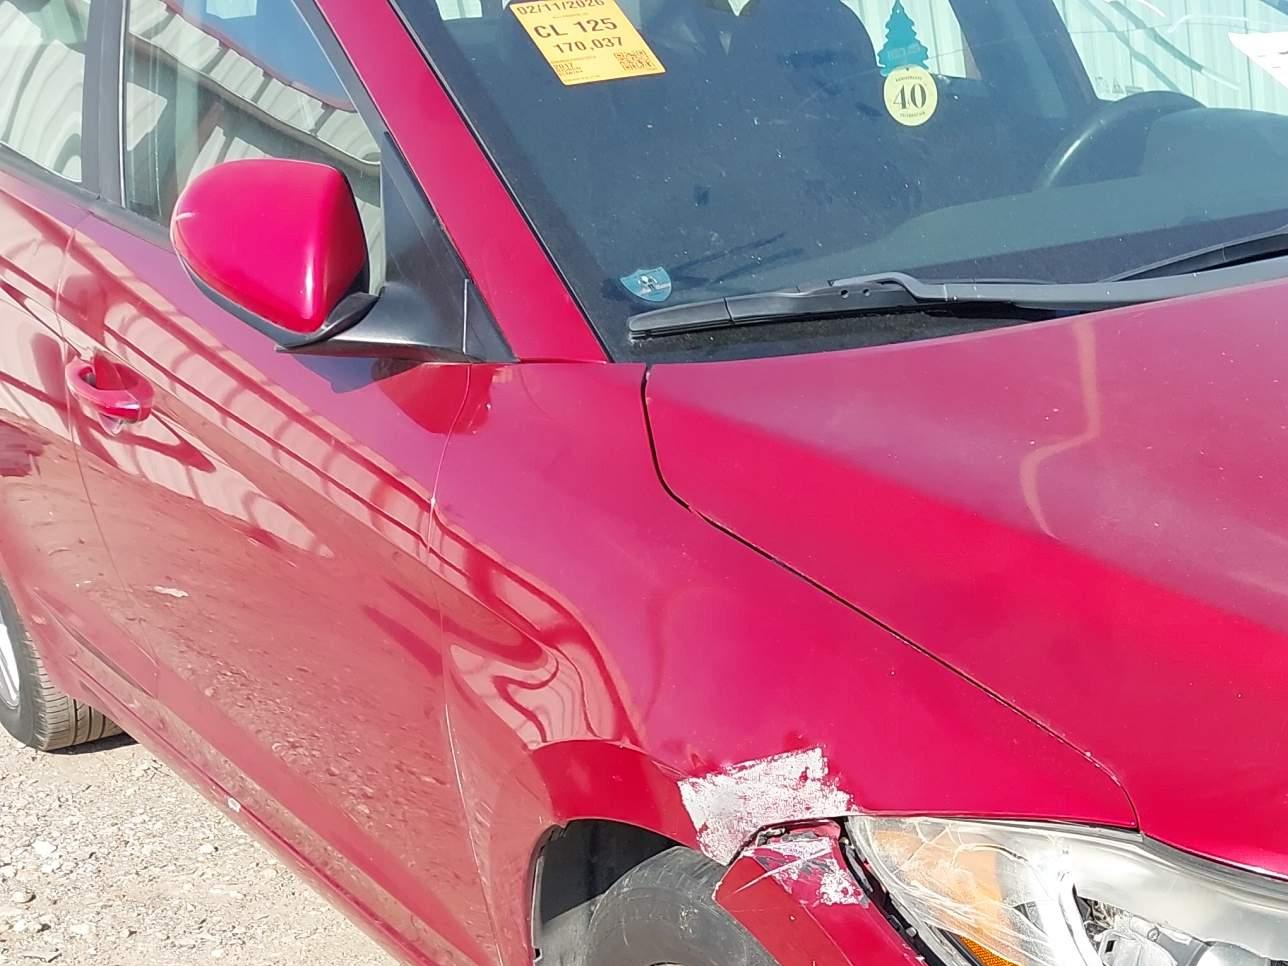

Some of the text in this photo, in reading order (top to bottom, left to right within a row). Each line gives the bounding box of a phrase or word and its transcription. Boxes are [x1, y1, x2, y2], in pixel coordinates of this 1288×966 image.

[534, 17, 617, 38] CL 125
[553, 37, 624, 54] 170,037
[893, 84, 927, 110] 40
